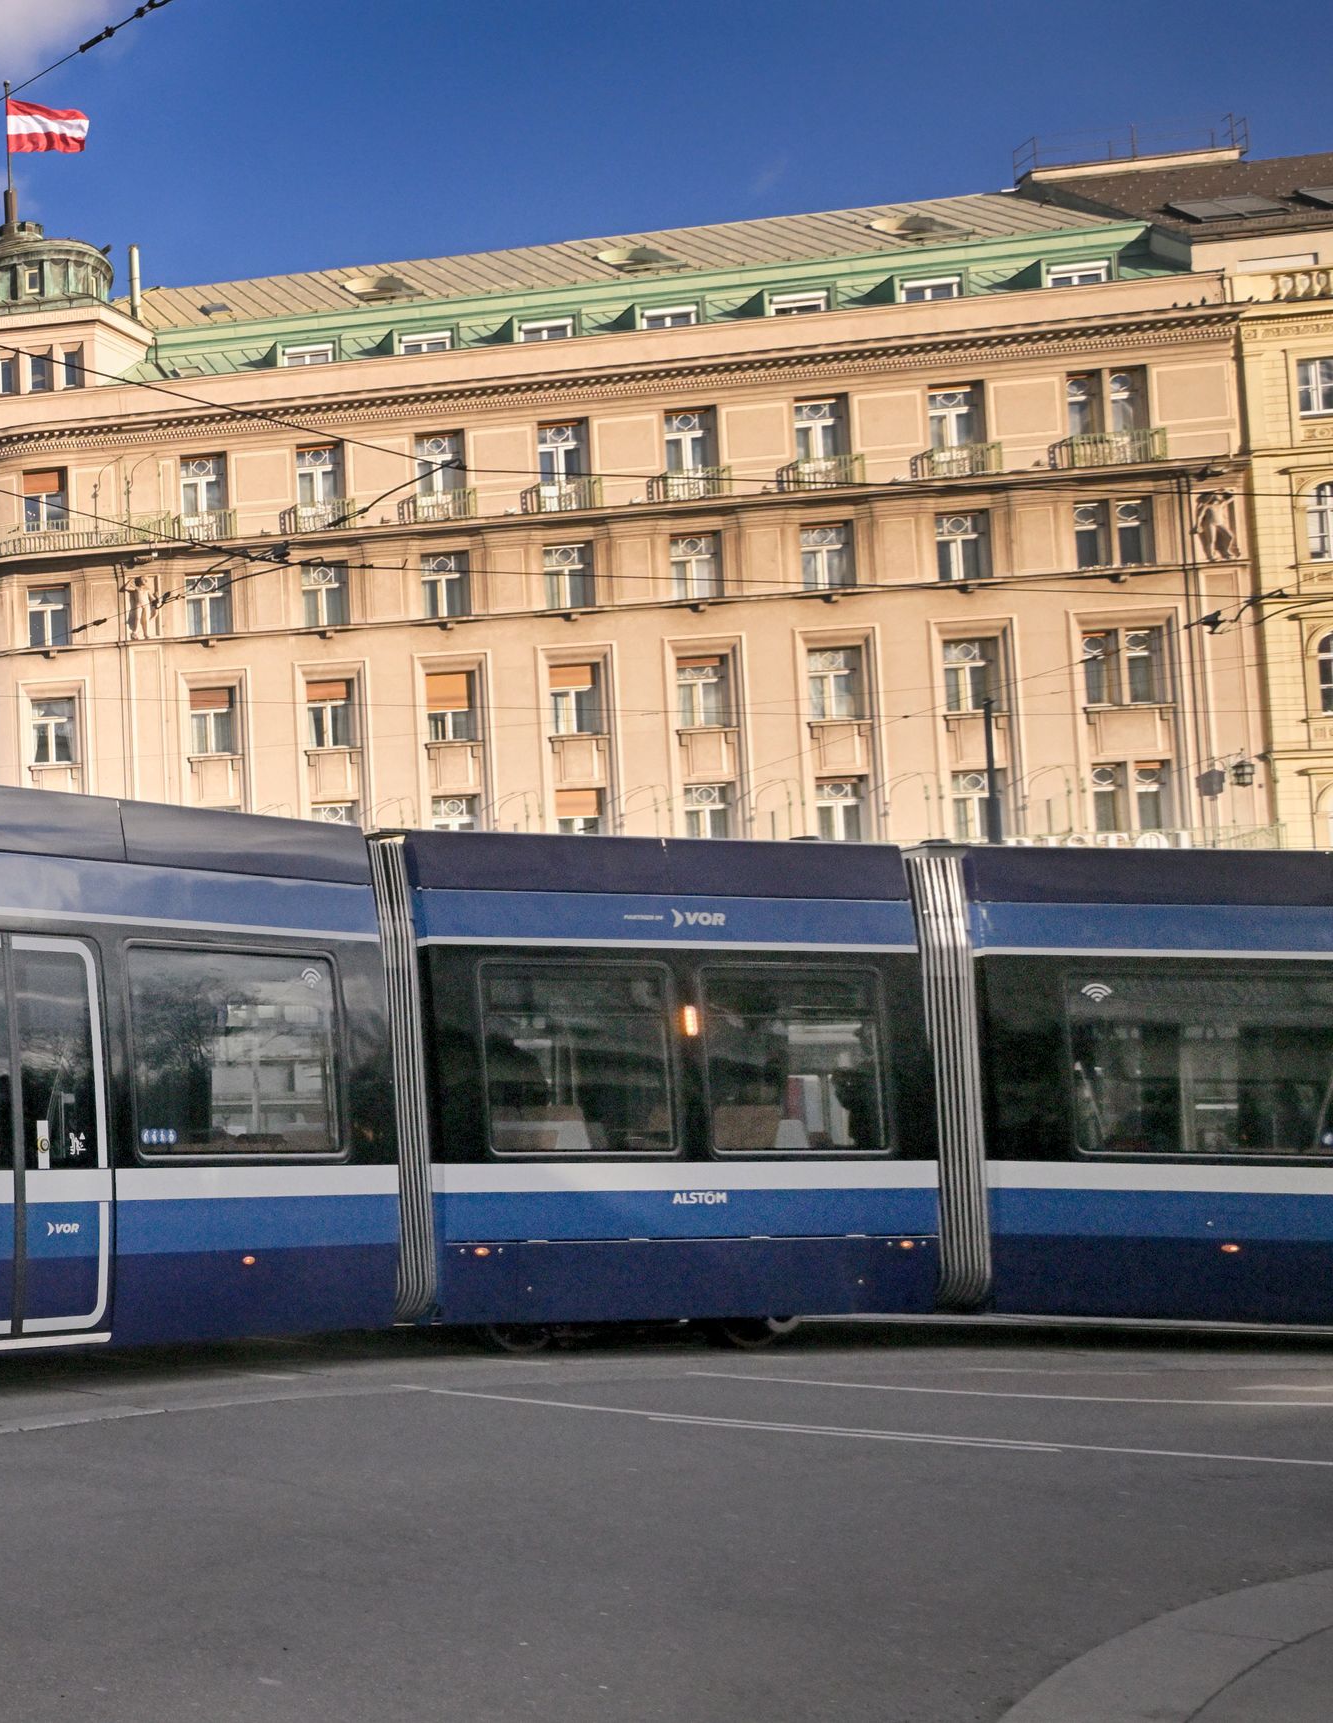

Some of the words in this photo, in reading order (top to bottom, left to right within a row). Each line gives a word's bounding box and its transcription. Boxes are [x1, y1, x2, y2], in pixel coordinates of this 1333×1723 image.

[684, 912, 726, 926] VOR
[672, 1191, 727, 1205] ALSTOM
[55, 1223, 80, 1234] VOR
